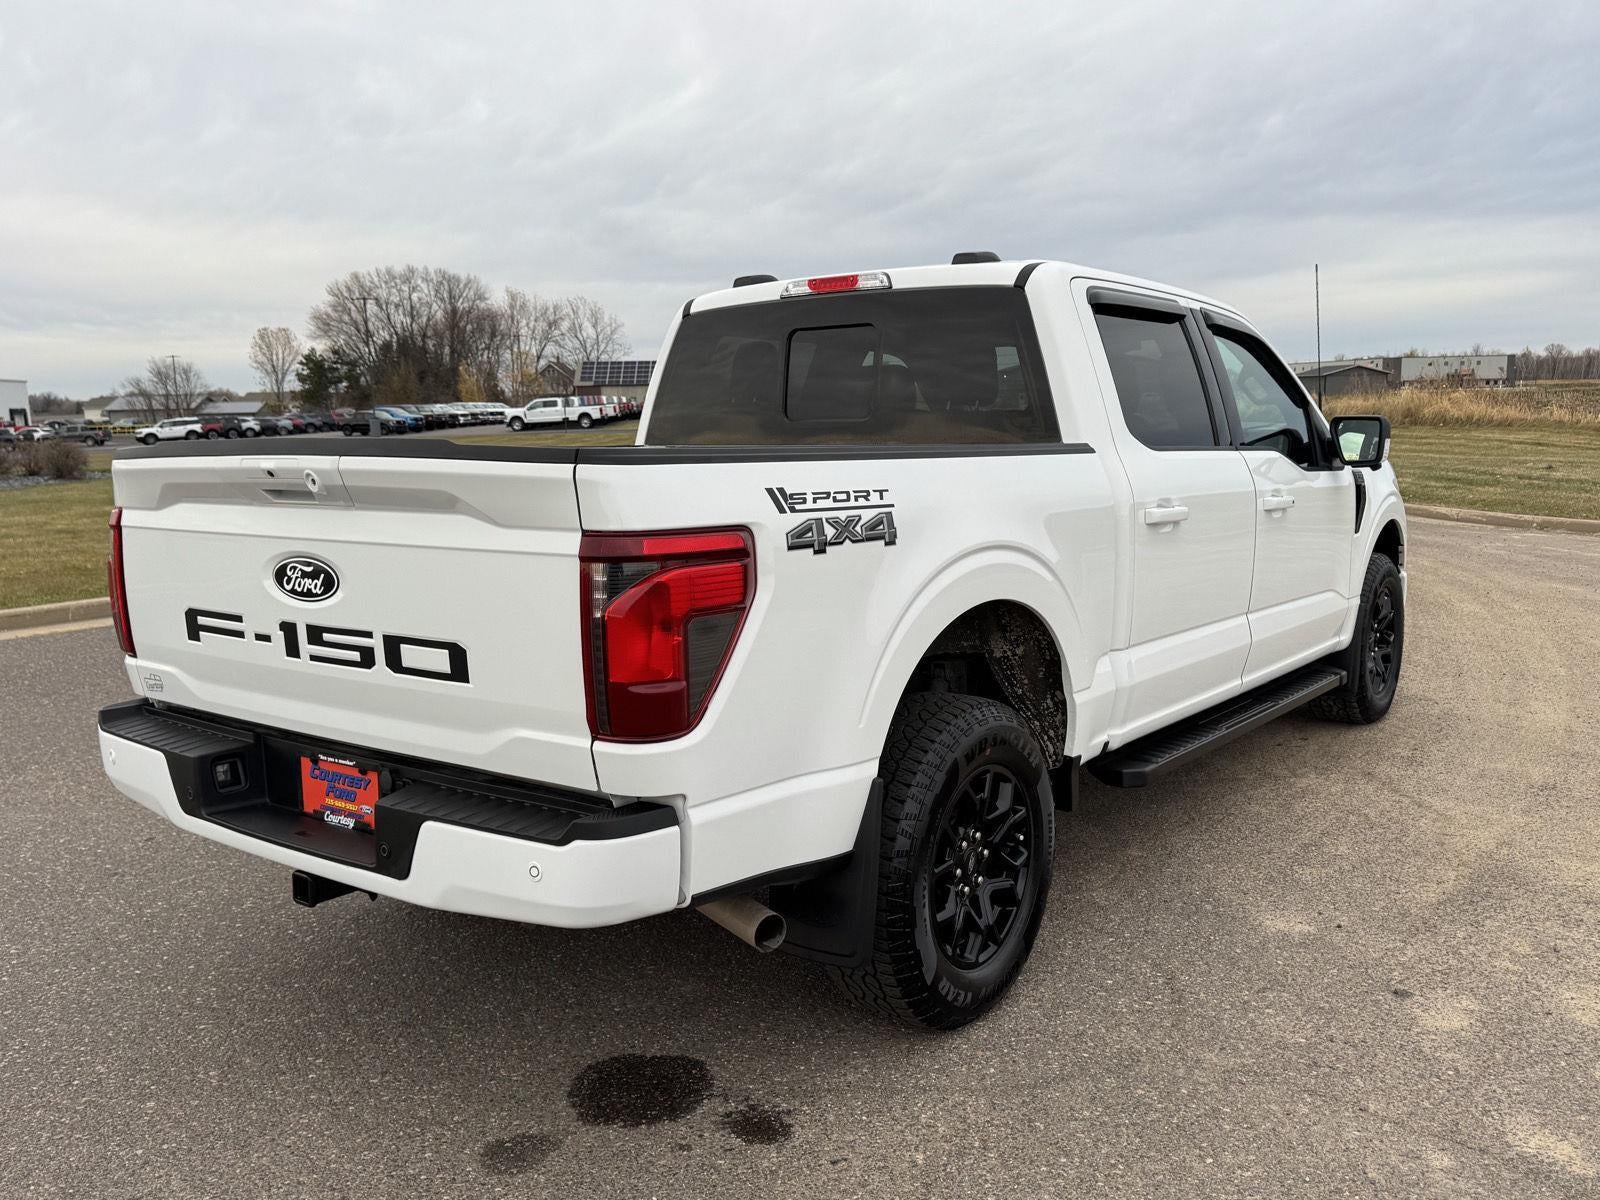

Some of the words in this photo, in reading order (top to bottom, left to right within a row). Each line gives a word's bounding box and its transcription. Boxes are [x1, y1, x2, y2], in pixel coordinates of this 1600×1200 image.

[788, 489, 889, 505] SPORT
[283, 562, 324, 594] Ford
[185, 607, 470, 685] F-150
[309, 764, 371, 790] COURTESY
[325, 782, 357, 802] FORD
[324, 811, 355, 829] Courtesy
